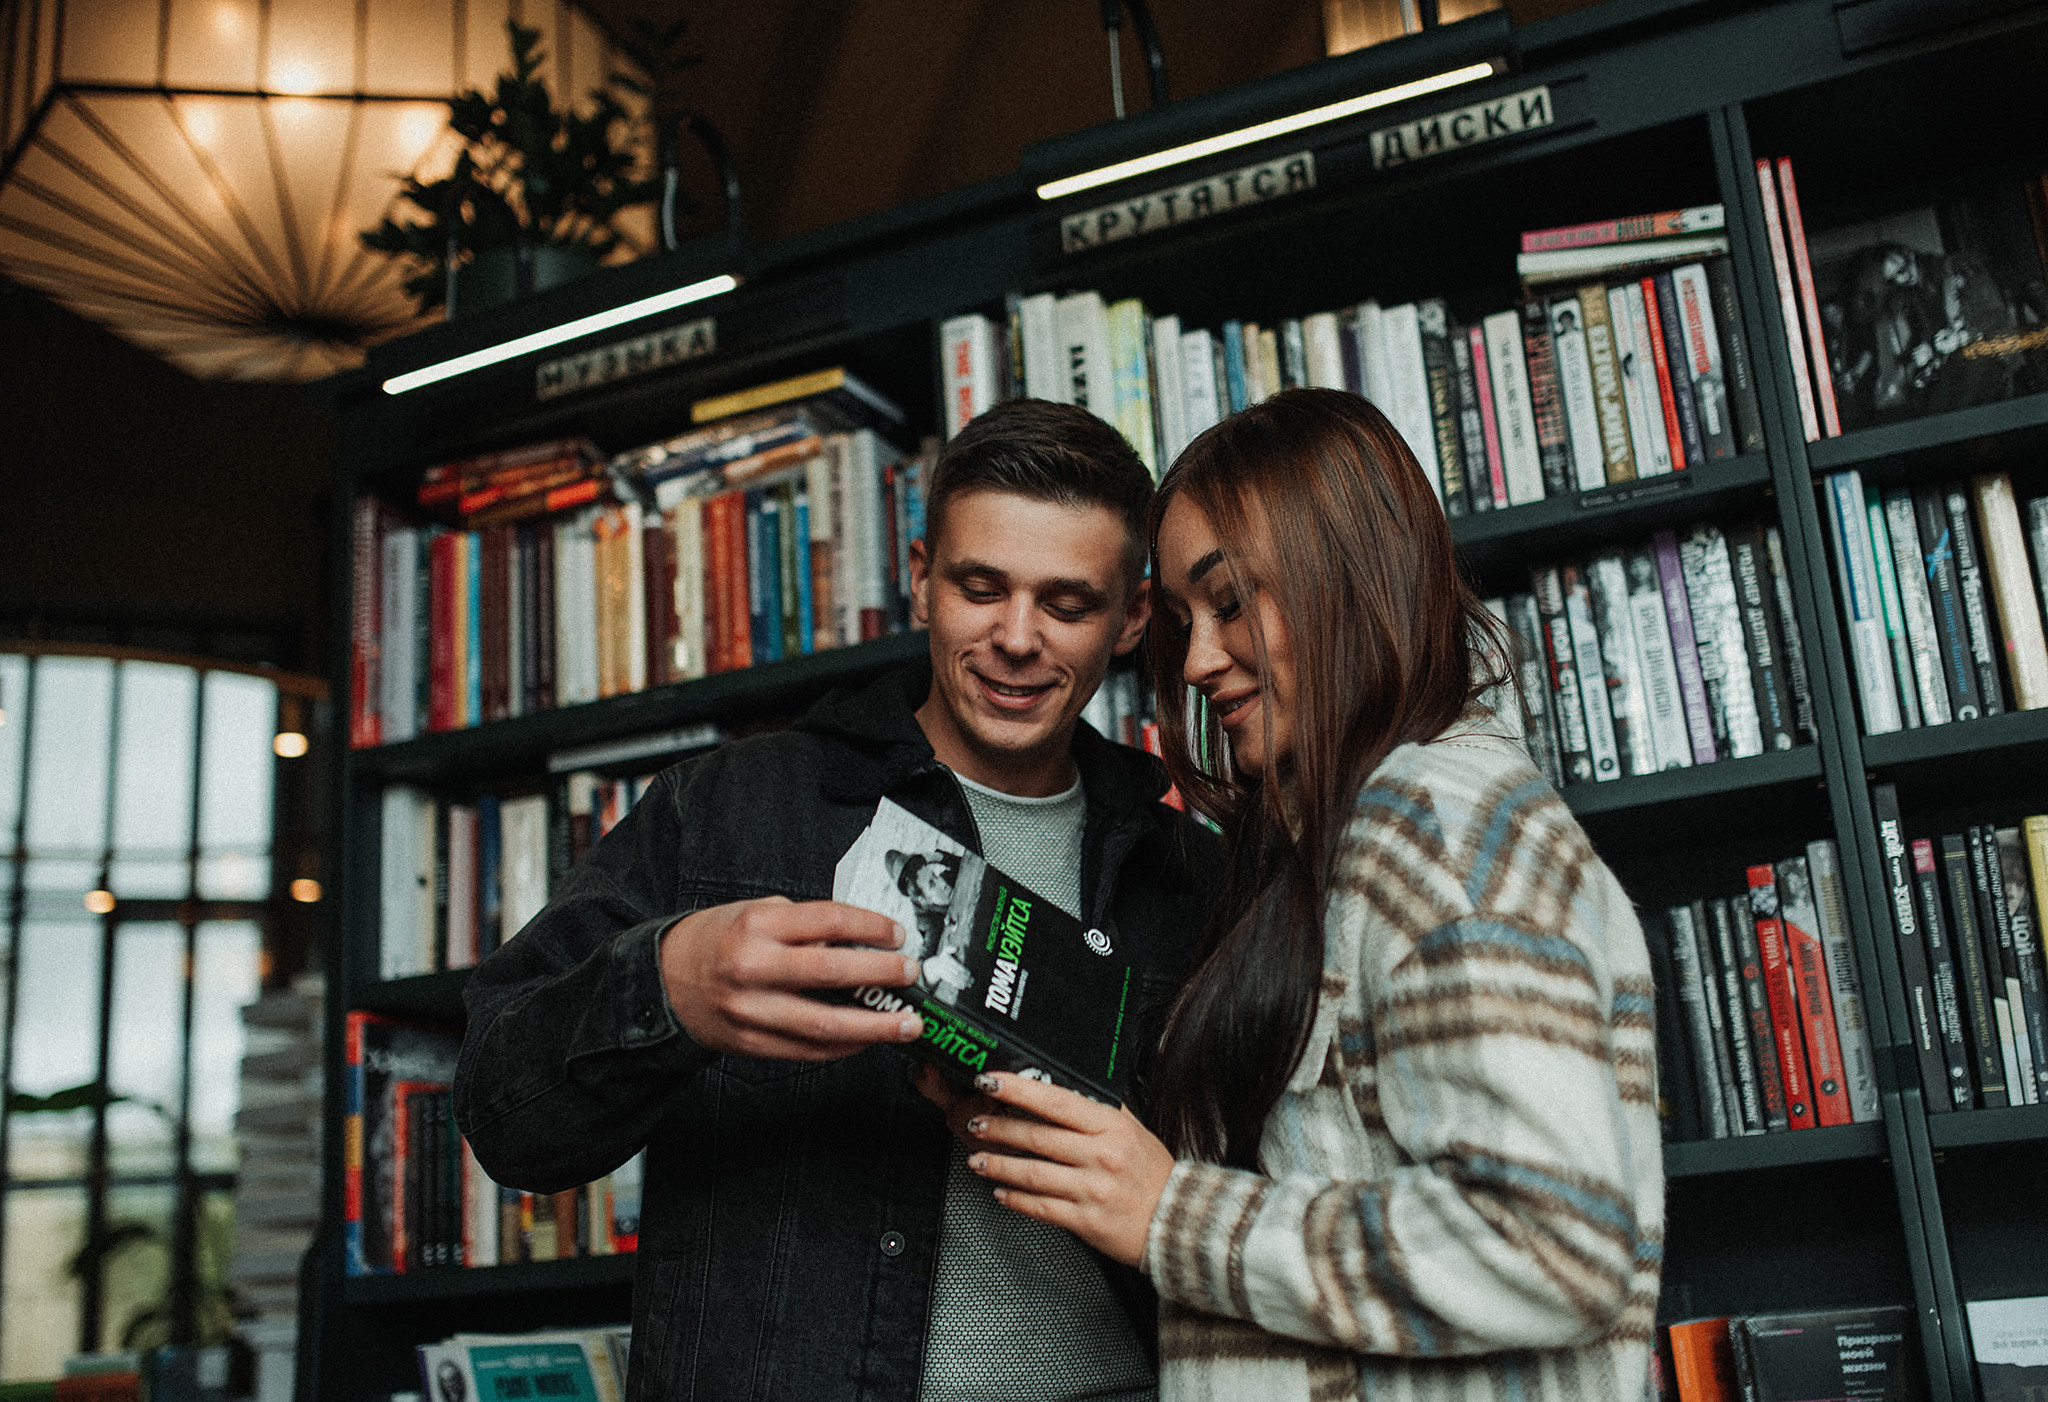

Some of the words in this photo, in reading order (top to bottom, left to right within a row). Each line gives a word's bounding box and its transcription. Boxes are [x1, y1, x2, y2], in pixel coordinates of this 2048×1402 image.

[1067, 157, 1310, 249] КРУТЯТСЯ
[1379, 93, 1547, 165] ДИСКИ
[1526, 334, 1563, 445] SPRINGSTEEN
[1588, 324, 1617, 396] ELTON
[1601, 396, 1628, 464] JOHN
[1737, 542, 1761, 607] РОДЖЕР
[1551, 617, 1570, 662] ПОЛ
[1747, 606, 1772, 667] ДОЛТРИ
[1558, 669, 1585, 751] СТЭНЛИ
[1879, 818, 1903, 859] ЦОЙ
[1894, 885, 1914, 935] КИНО
[1985, 844, 2003, 899] АЛЕКСАНДР
[998, 898, 1032, 965] УЭЙТСА
[1762, 926, 1780, 969] ТИНА
[2010, 913, 2033, 957] ЦОЙ
[985, 958, 1019, 1014] ТОМА
[1837, 1334, 1903, 1348] Призраки
[1840, 1347, 1875, 1361] моей
[1841, 1362, 1887, 1374] жизни
